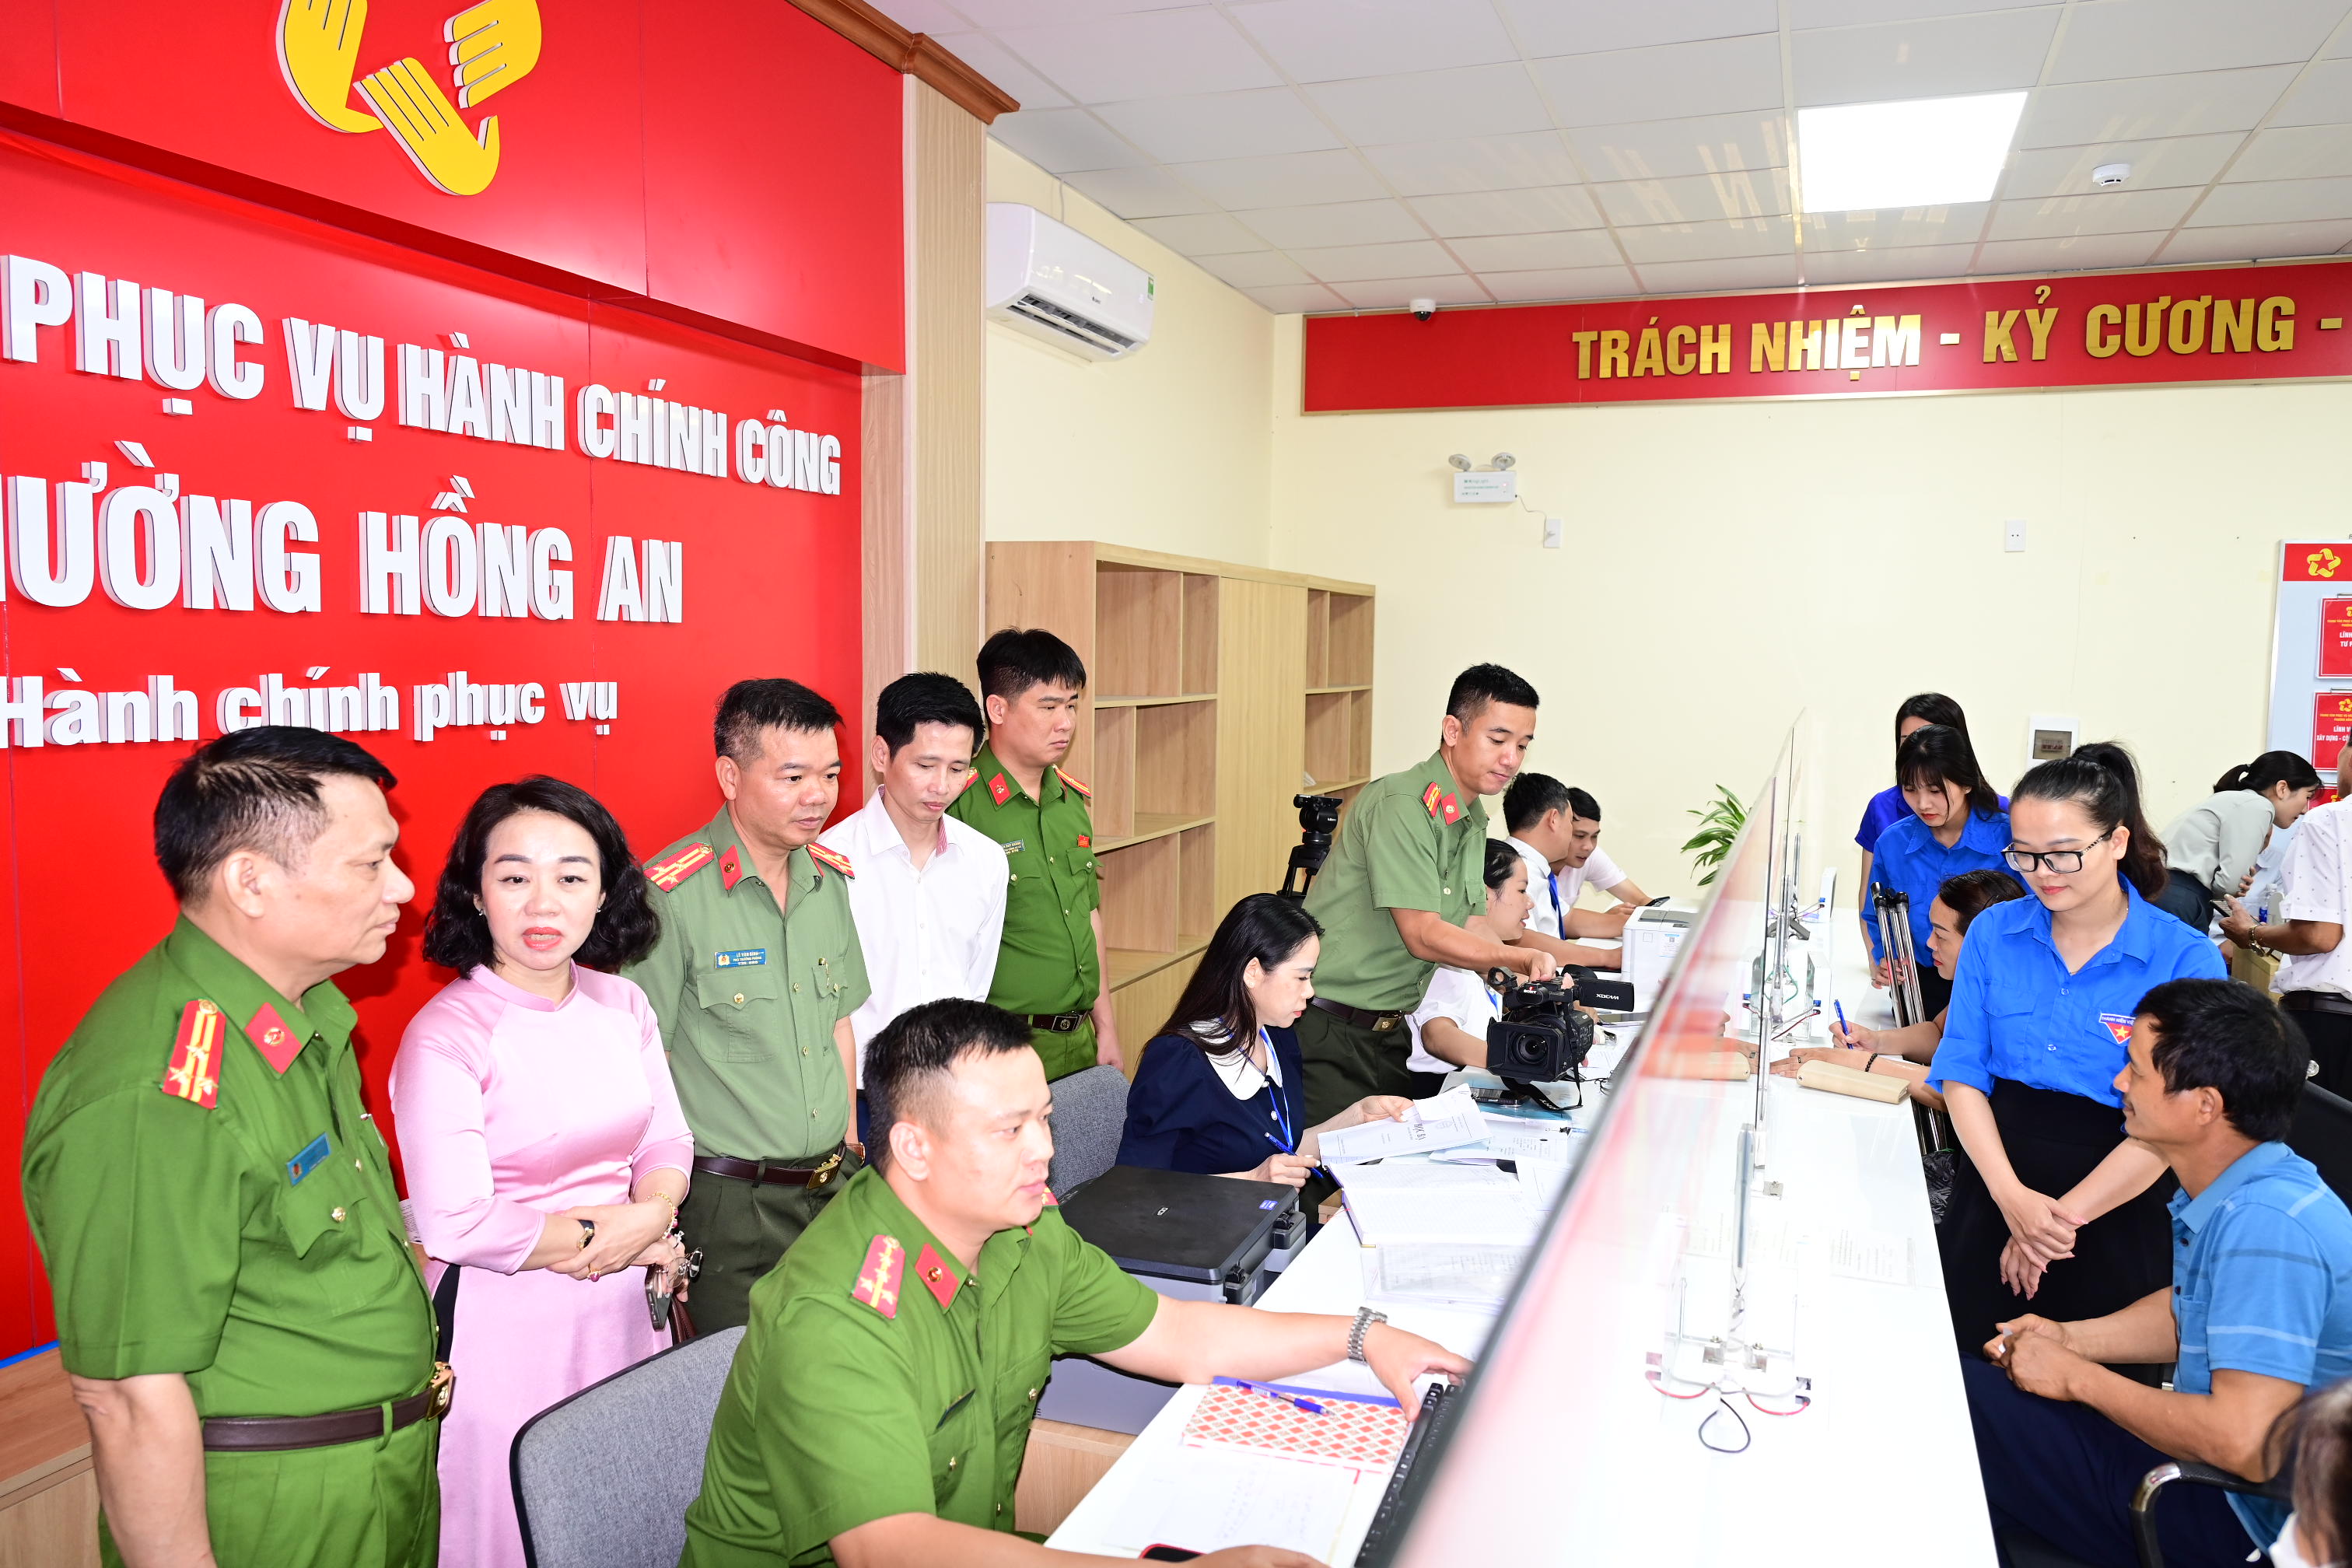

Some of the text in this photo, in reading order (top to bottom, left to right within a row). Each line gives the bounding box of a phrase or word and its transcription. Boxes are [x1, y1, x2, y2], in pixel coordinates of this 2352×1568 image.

[0, 254, 842, 495] PHỤC VỤ HÀNH CHÍNH CÔNG
[1572, 317, 1731, 380] TRÁCH
[1749, 304, 1922, 380] NHIỆM
[1983, 285, 2060, 363] KỶ
[2085, 295, 2296, 359] CƯƠNG
[0, 440, 683, 623] ƯỜNG HỒNG AN
[0, 666, 618, 749] Hành chính phục vụ
